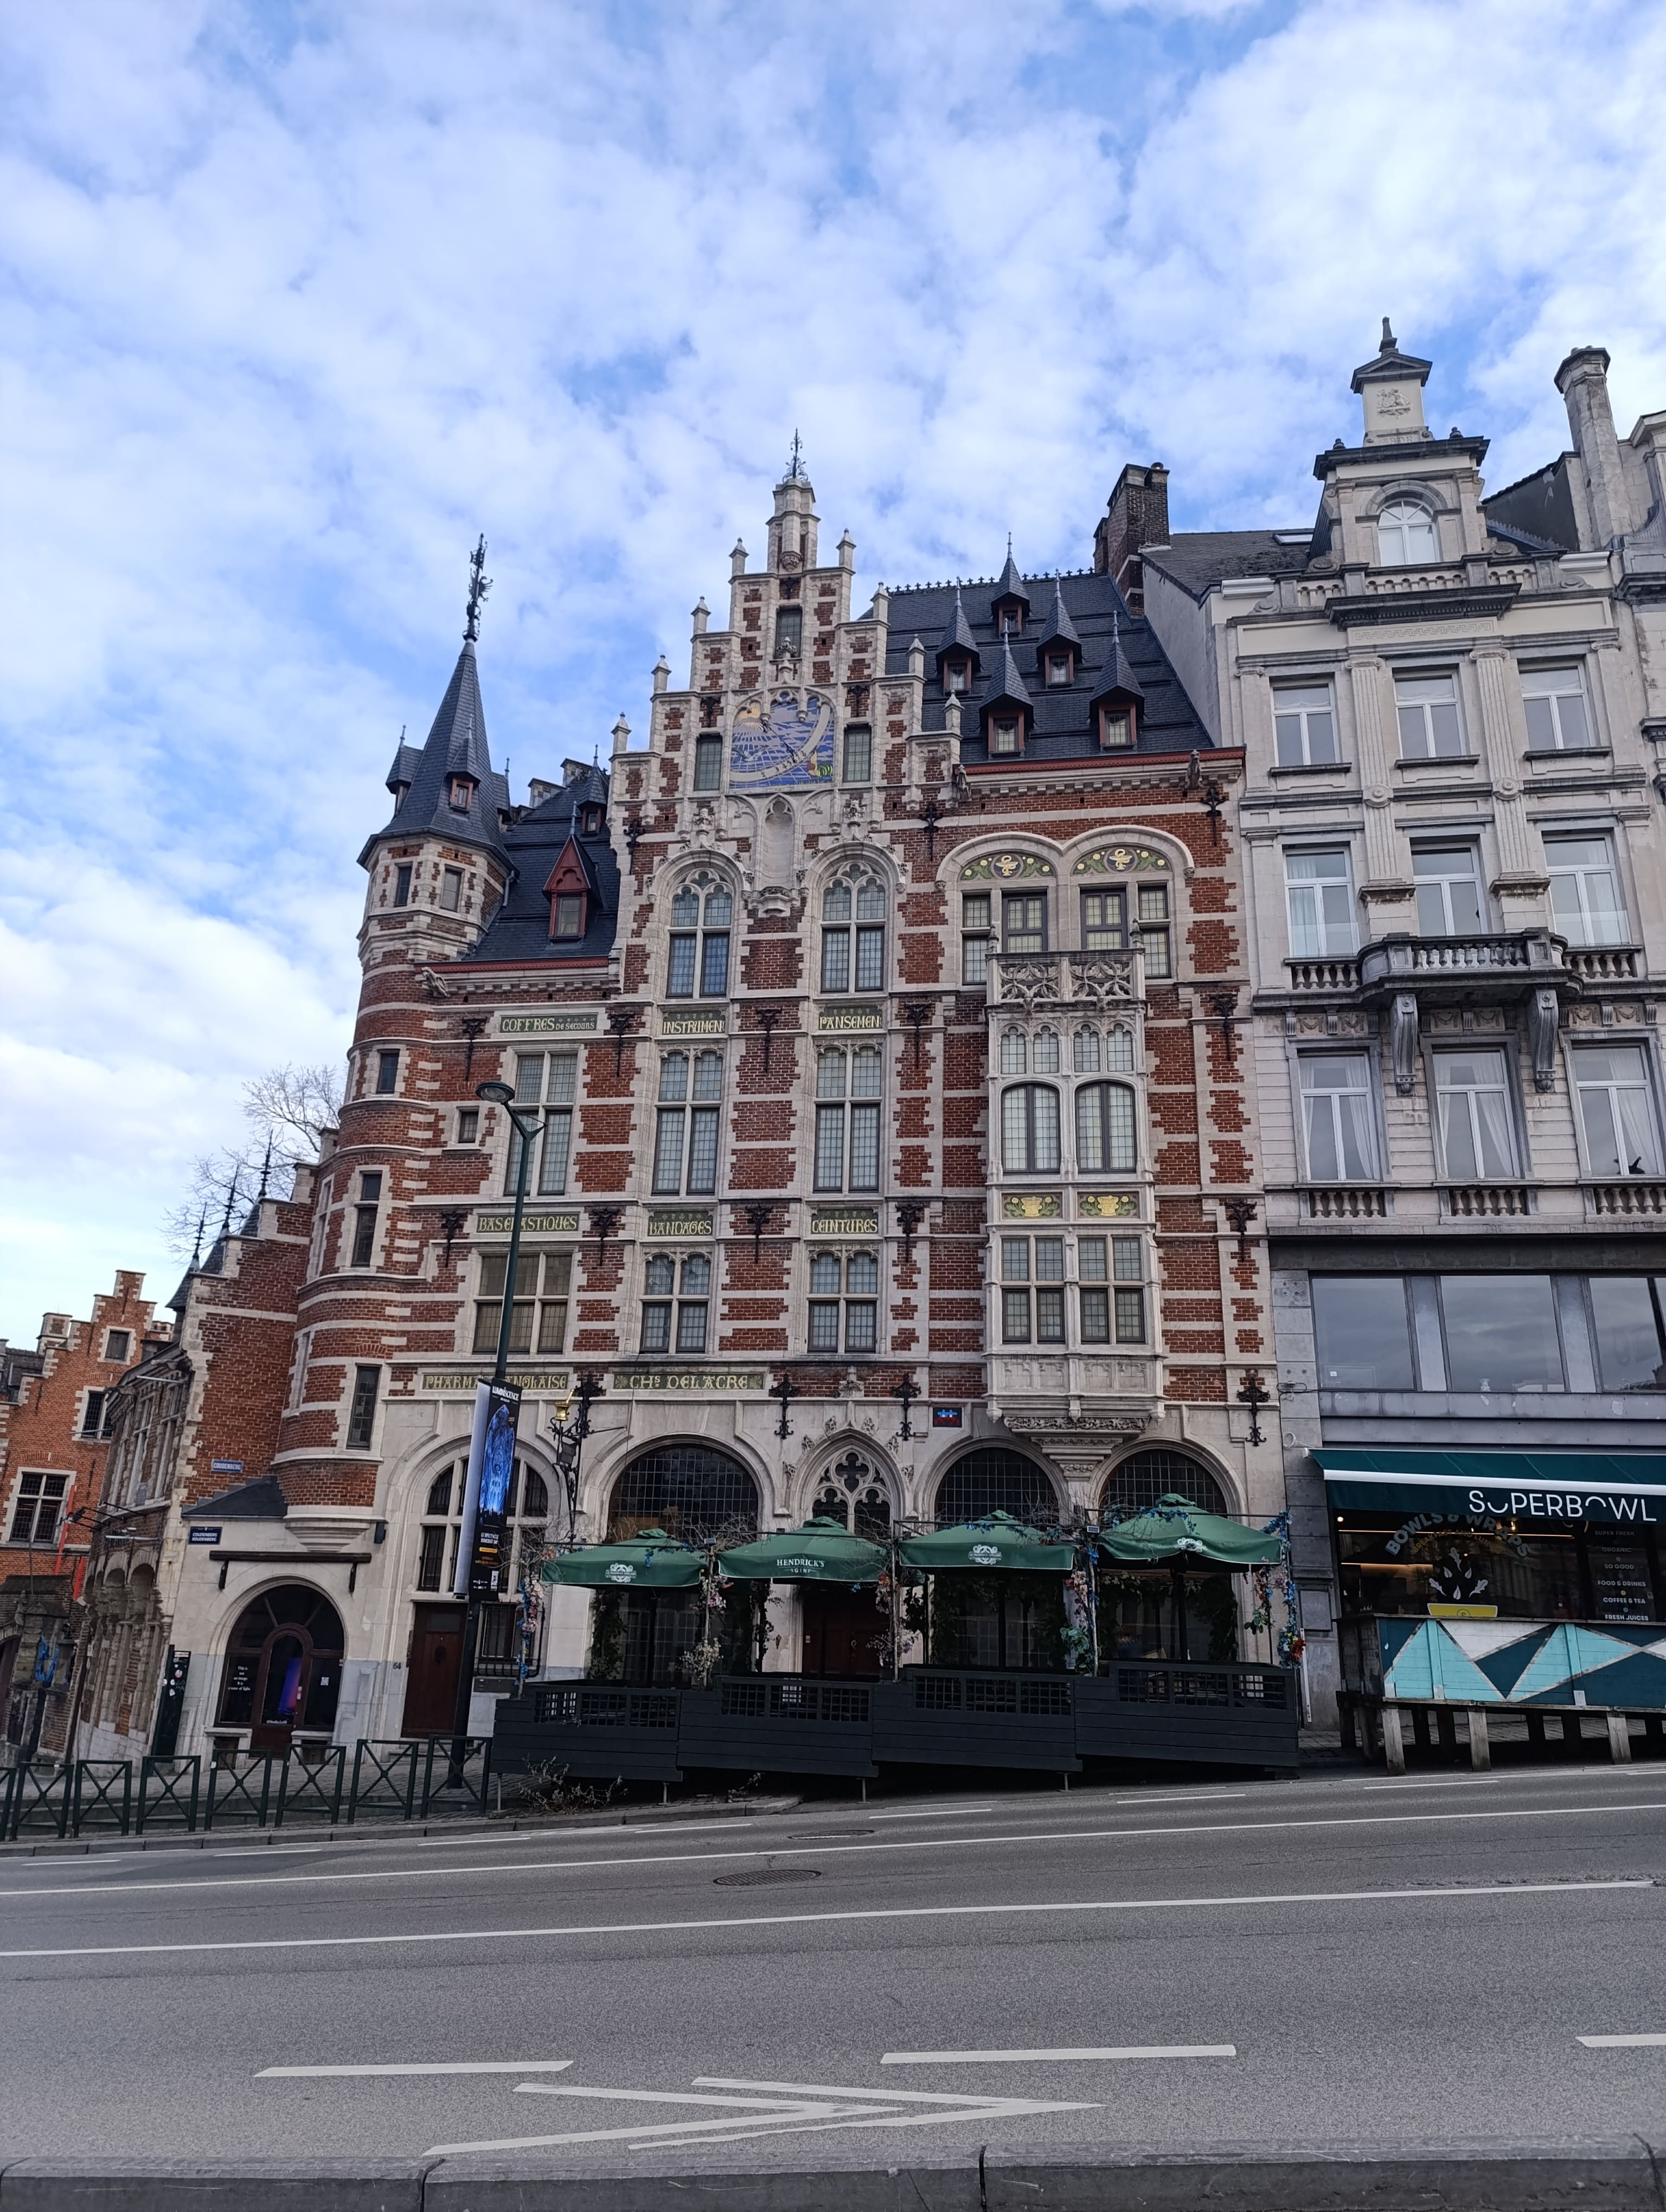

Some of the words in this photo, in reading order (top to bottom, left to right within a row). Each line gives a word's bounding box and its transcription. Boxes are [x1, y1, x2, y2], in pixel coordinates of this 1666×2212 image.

[502, 1018, 555, 1032] COFFRES
[478, 1217, 503, 1231] BAS
[649, 1220, 712, 1236] BANDAGES
[812, 1218, 878, 1233] CEINTURES
[425, 1375, 494, 1390] PHARM
[667, 1375, 748, 1389] DELACRE
[1469, 1490, 1657, 1522] SUPERBOWL
[1385, 1513, 1444, 1557] BOWLS
[1465, 1515, 1533, 1557] WRAPS
[776, 1559, 824, 1567] HENDRICK'S
[393, 1662, 401, 1670] 64
